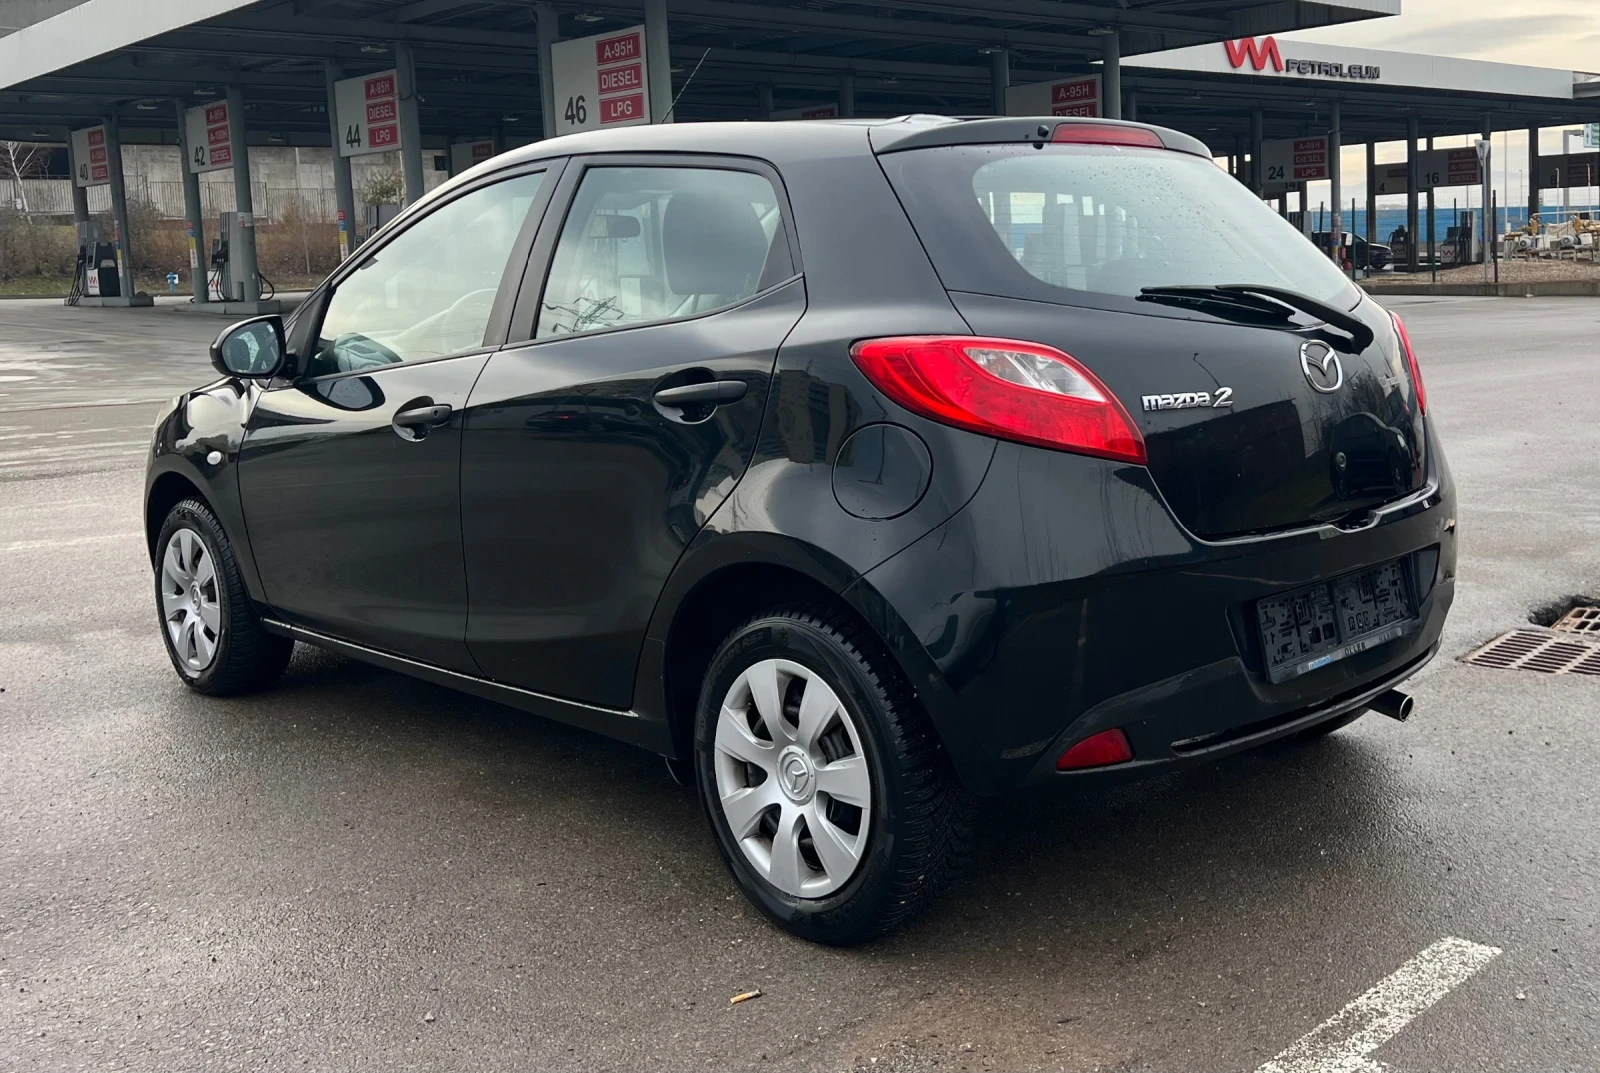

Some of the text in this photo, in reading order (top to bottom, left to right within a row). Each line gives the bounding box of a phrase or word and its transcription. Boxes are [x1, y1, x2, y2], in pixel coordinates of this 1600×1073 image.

[604, 40, 634, 59] A-95H
[1286, 58, 1380, 79] PETROLEUM
[601, 69, 638, 89] DIESEL
[370, 80, 390, 96] A-95H
[1059, 84, 1089, 99] A-95H
[368, 104, 394, 120] DIESEL
[565, 95, 587, 125] 46
[611, 100, 632, 117] LPG
[346, 124, 361, 148] 44
[375, 129, 390, 143] LPG
[1299, 142, 1320, 150] A-95H
[194, 145, 206, 166] 42
[211, 149, 230, 161] DIESEL
[1295, 155, 1322, 163] DIESEL
[80, 163, 88, 180] 40
[1268, 165, 1285, 180] 24
[1301, 168, 1317, 176] LPG
[1424, 172, 1440, 184] 16
[1379, 182, 1386, 192] 4
